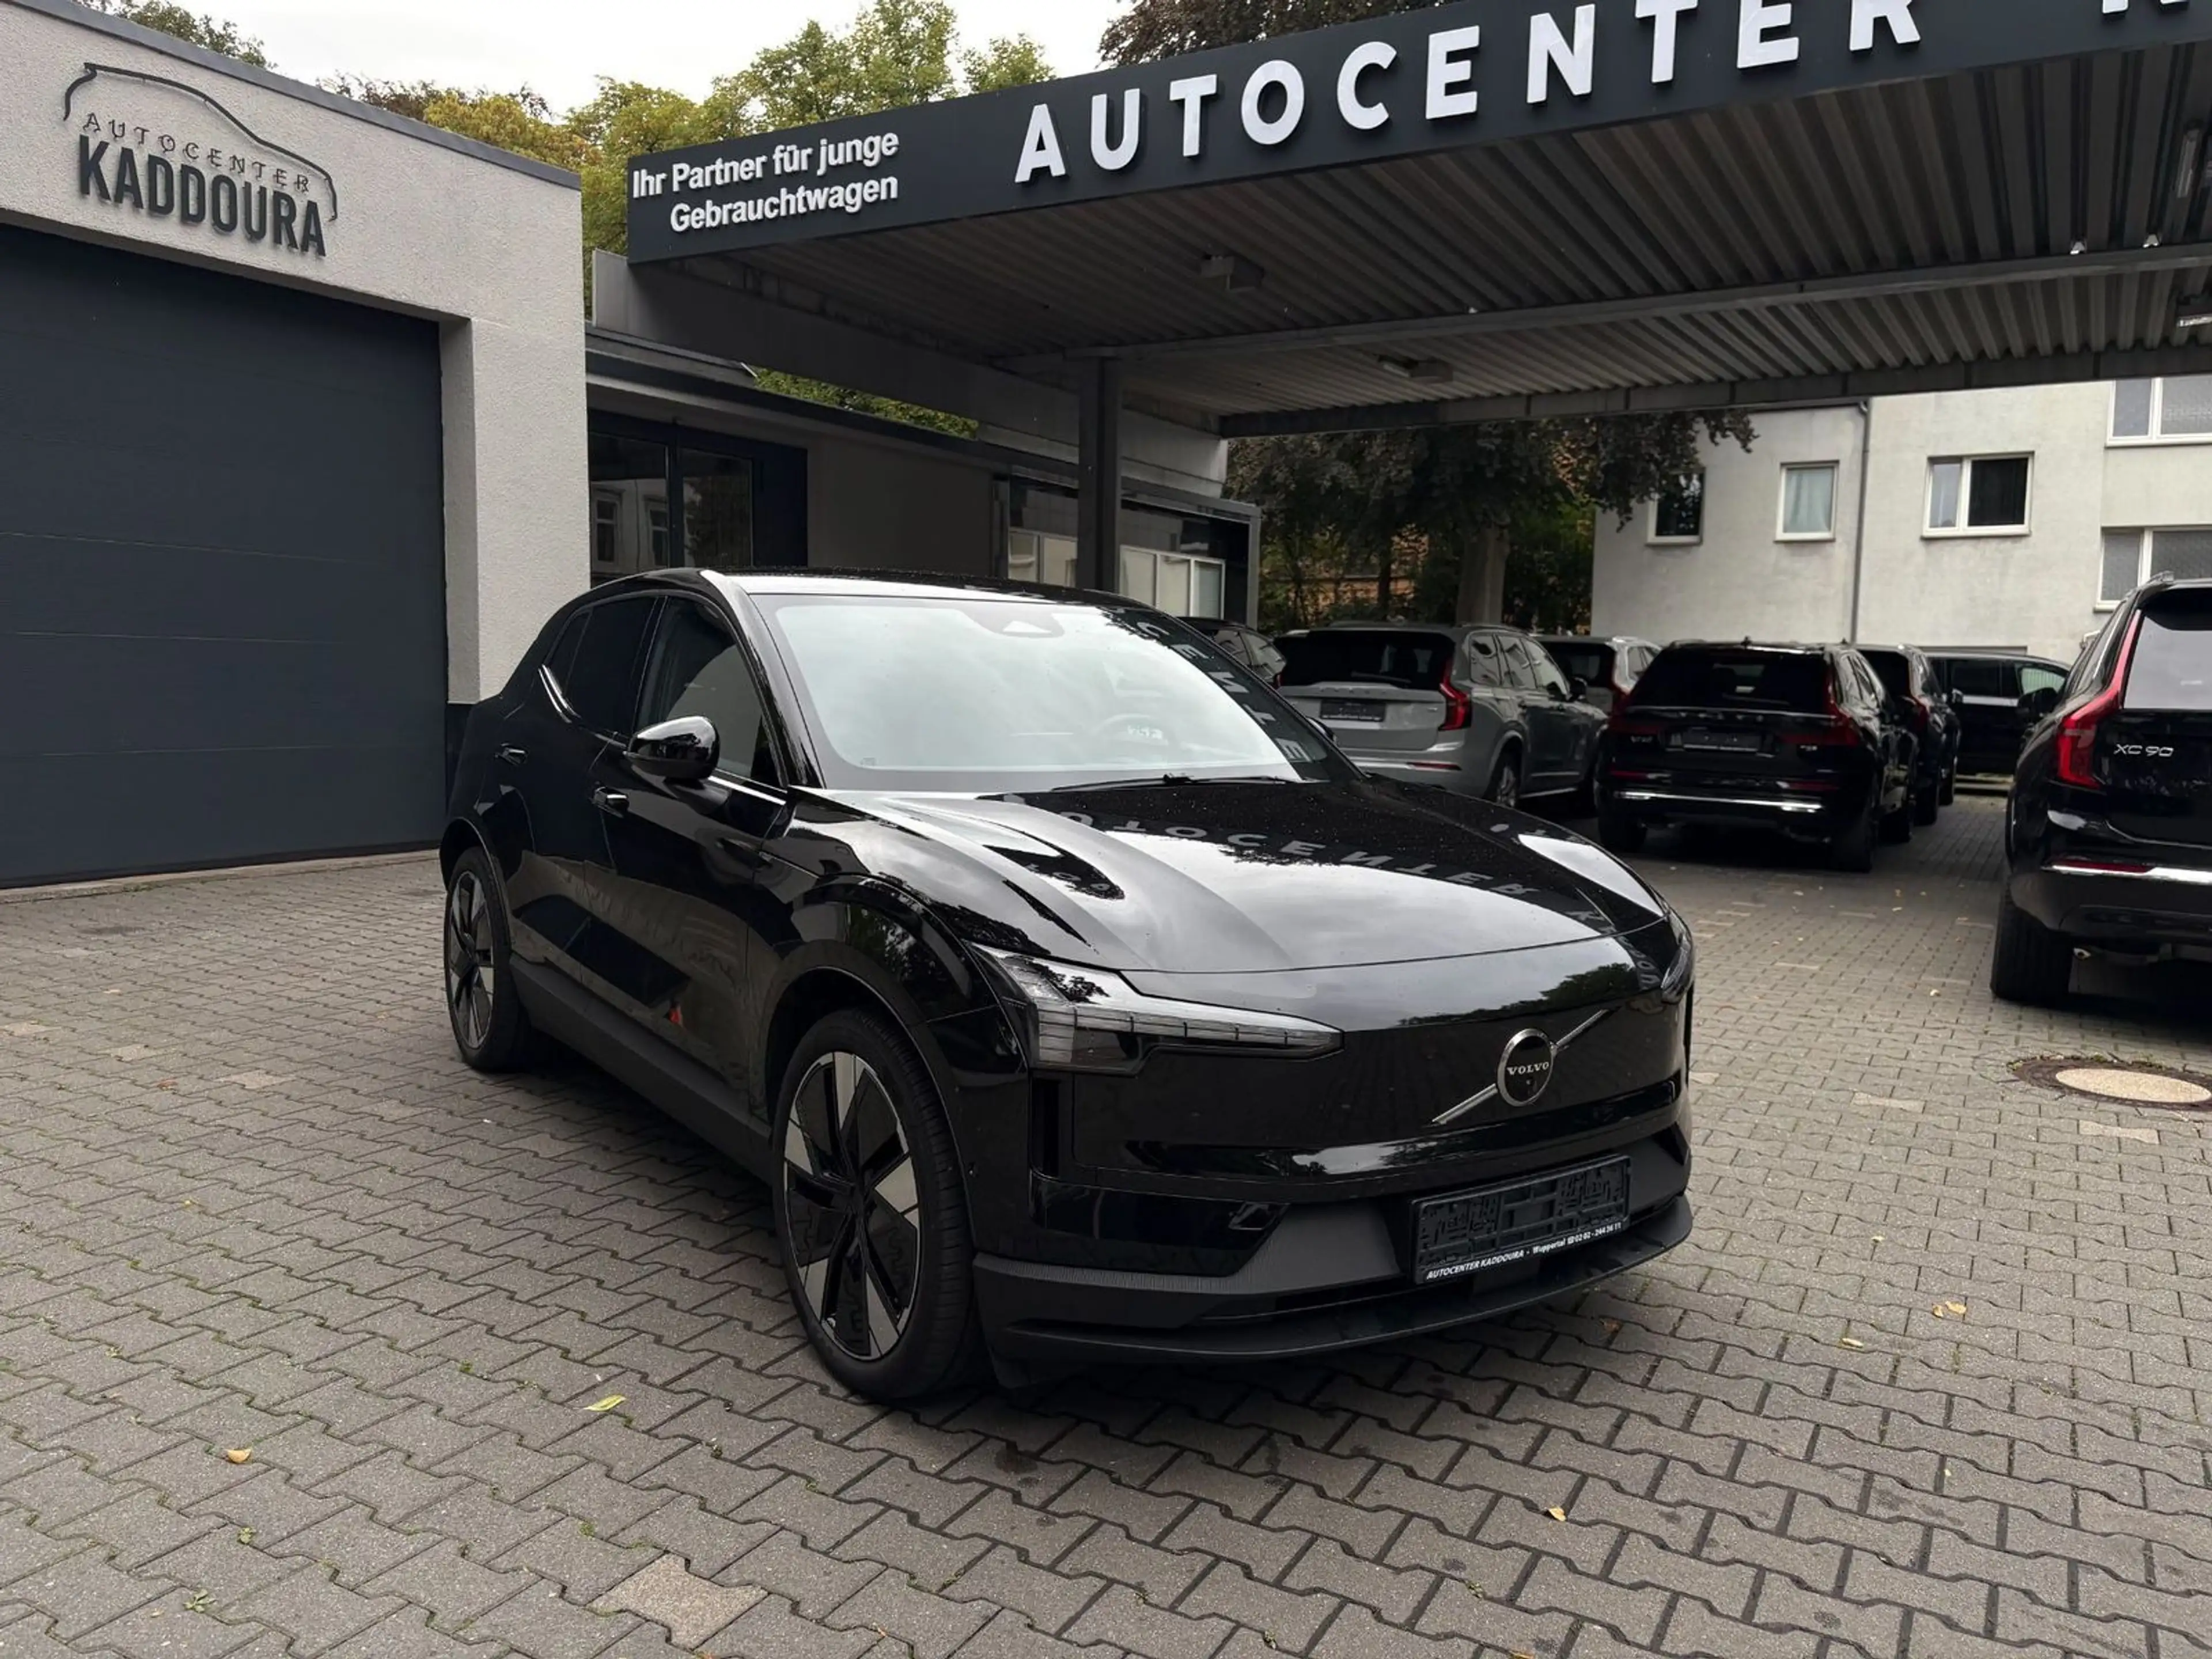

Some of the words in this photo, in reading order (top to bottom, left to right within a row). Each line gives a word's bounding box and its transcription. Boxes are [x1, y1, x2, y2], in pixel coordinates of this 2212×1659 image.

[82, 112, 310, 192] AUTOCENTER
[632, 169, 667, 198] Ihr
[672, 152, 768, 192] Partner
[772, 143, 813, 175] für
[816, 131, 900, 176] junge
[78, 135, 327, 257] KADDOURA
[670, 175, 899, 232] Gebrauchtwagen
[1506, 1061, 1550, 1075] VOLVO
[1426, 1260, 1480, 1279] AUTOCENTER
[1480, 1249, 1525, 1268] KADDOURA
